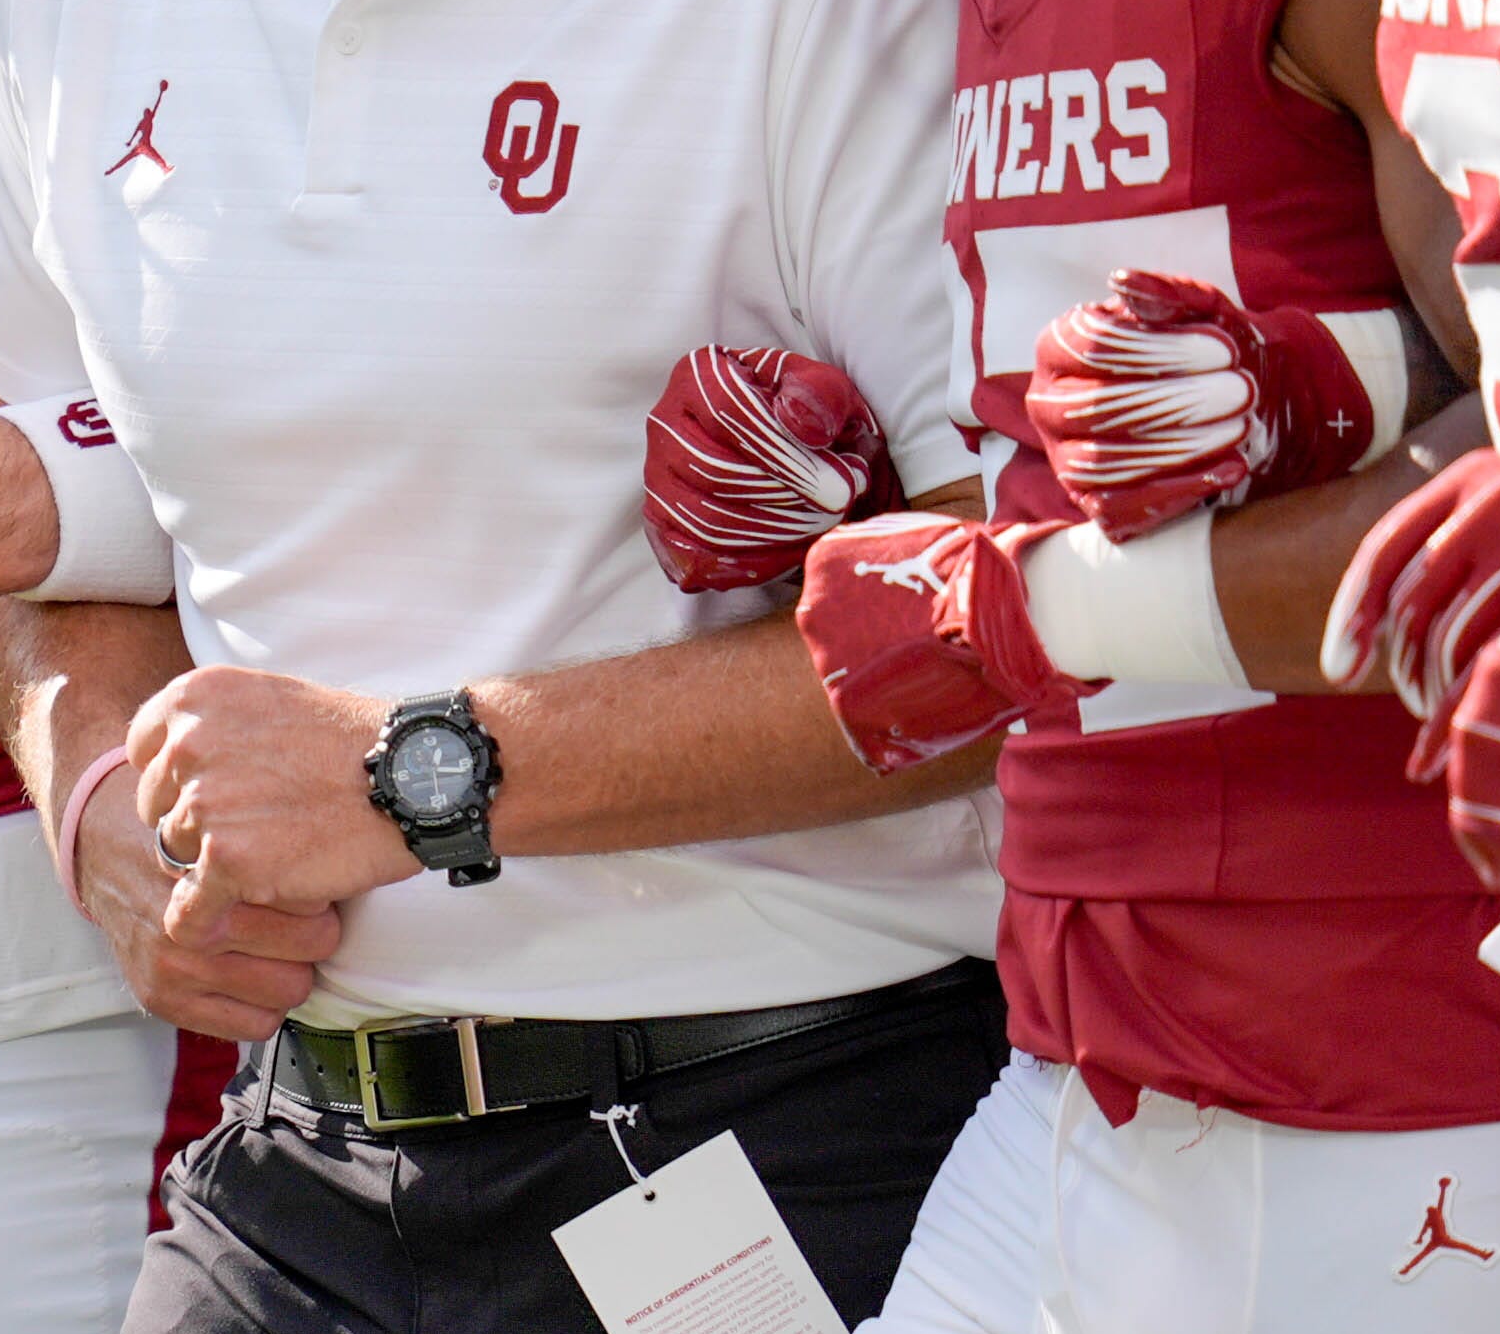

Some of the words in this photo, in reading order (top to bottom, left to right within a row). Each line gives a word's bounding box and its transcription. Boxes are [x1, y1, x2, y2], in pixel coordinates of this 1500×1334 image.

[482, 80, 580, 215] OU
[624, 1304, 654, 1325] NOTICE
[652, 1298, 664, 1309] OF
[664, 1271, 711, 1302] CREDENTIAL
[710, 1262, 727, 1275] USE
[726, 1235, 772, 1266] CONDITIONS
